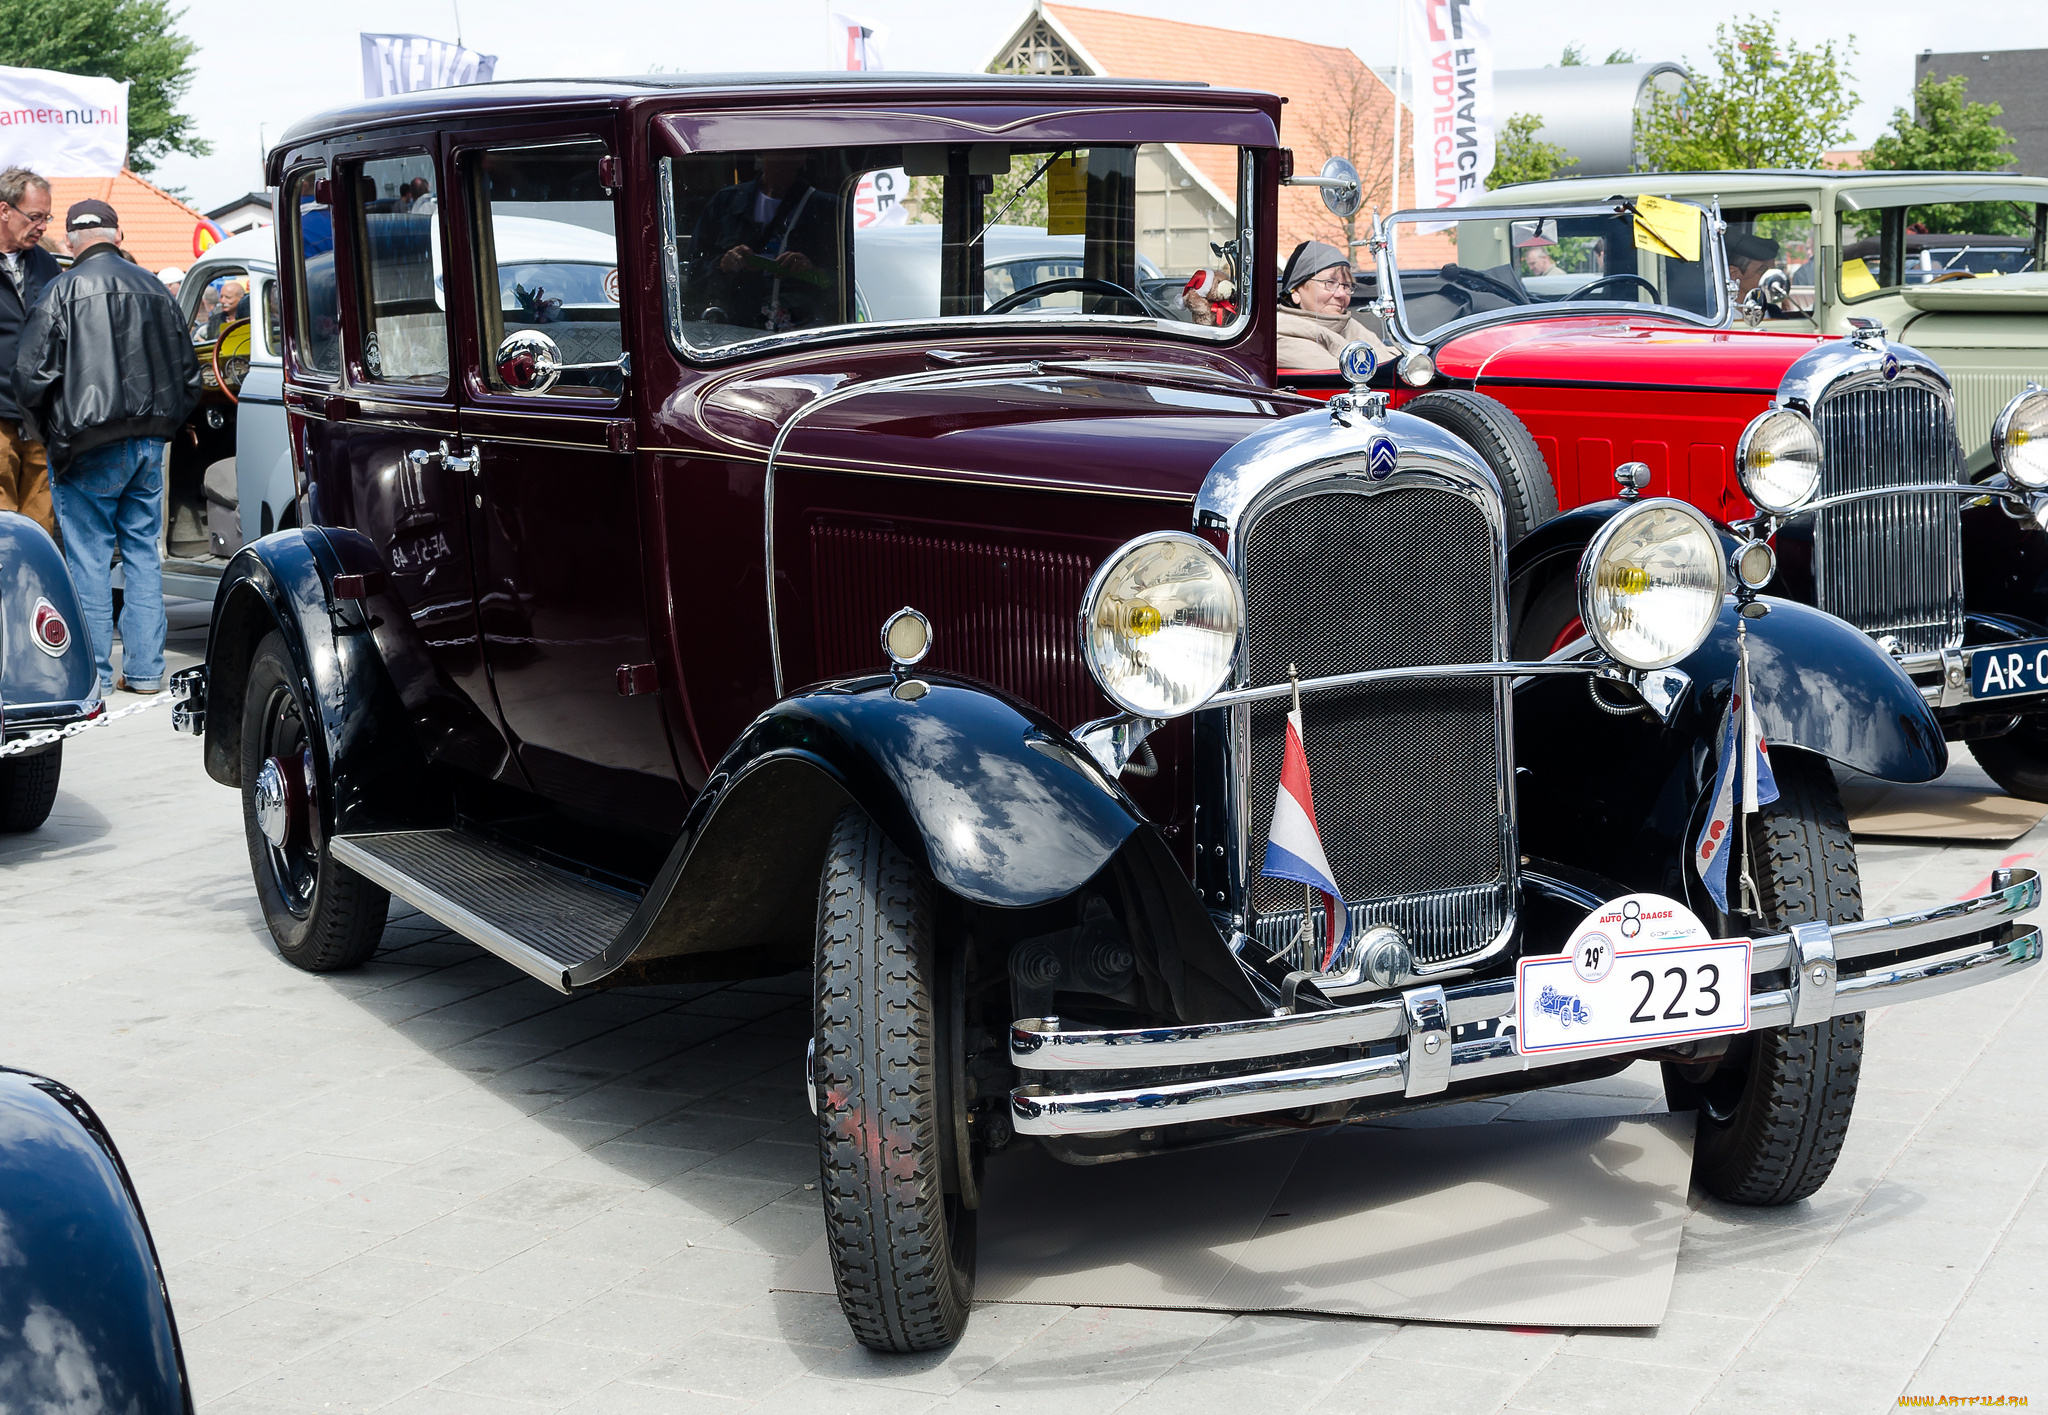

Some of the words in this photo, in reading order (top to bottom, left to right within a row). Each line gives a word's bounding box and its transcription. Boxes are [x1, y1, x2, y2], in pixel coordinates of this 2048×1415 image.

[0, 105, 118, 126] ameranu.nl
[1600, 915, 1621, 923] AUTO
[1640, 911, 1673, 920] DAAGSE
[1629, 963, 1721, 1023] 223
